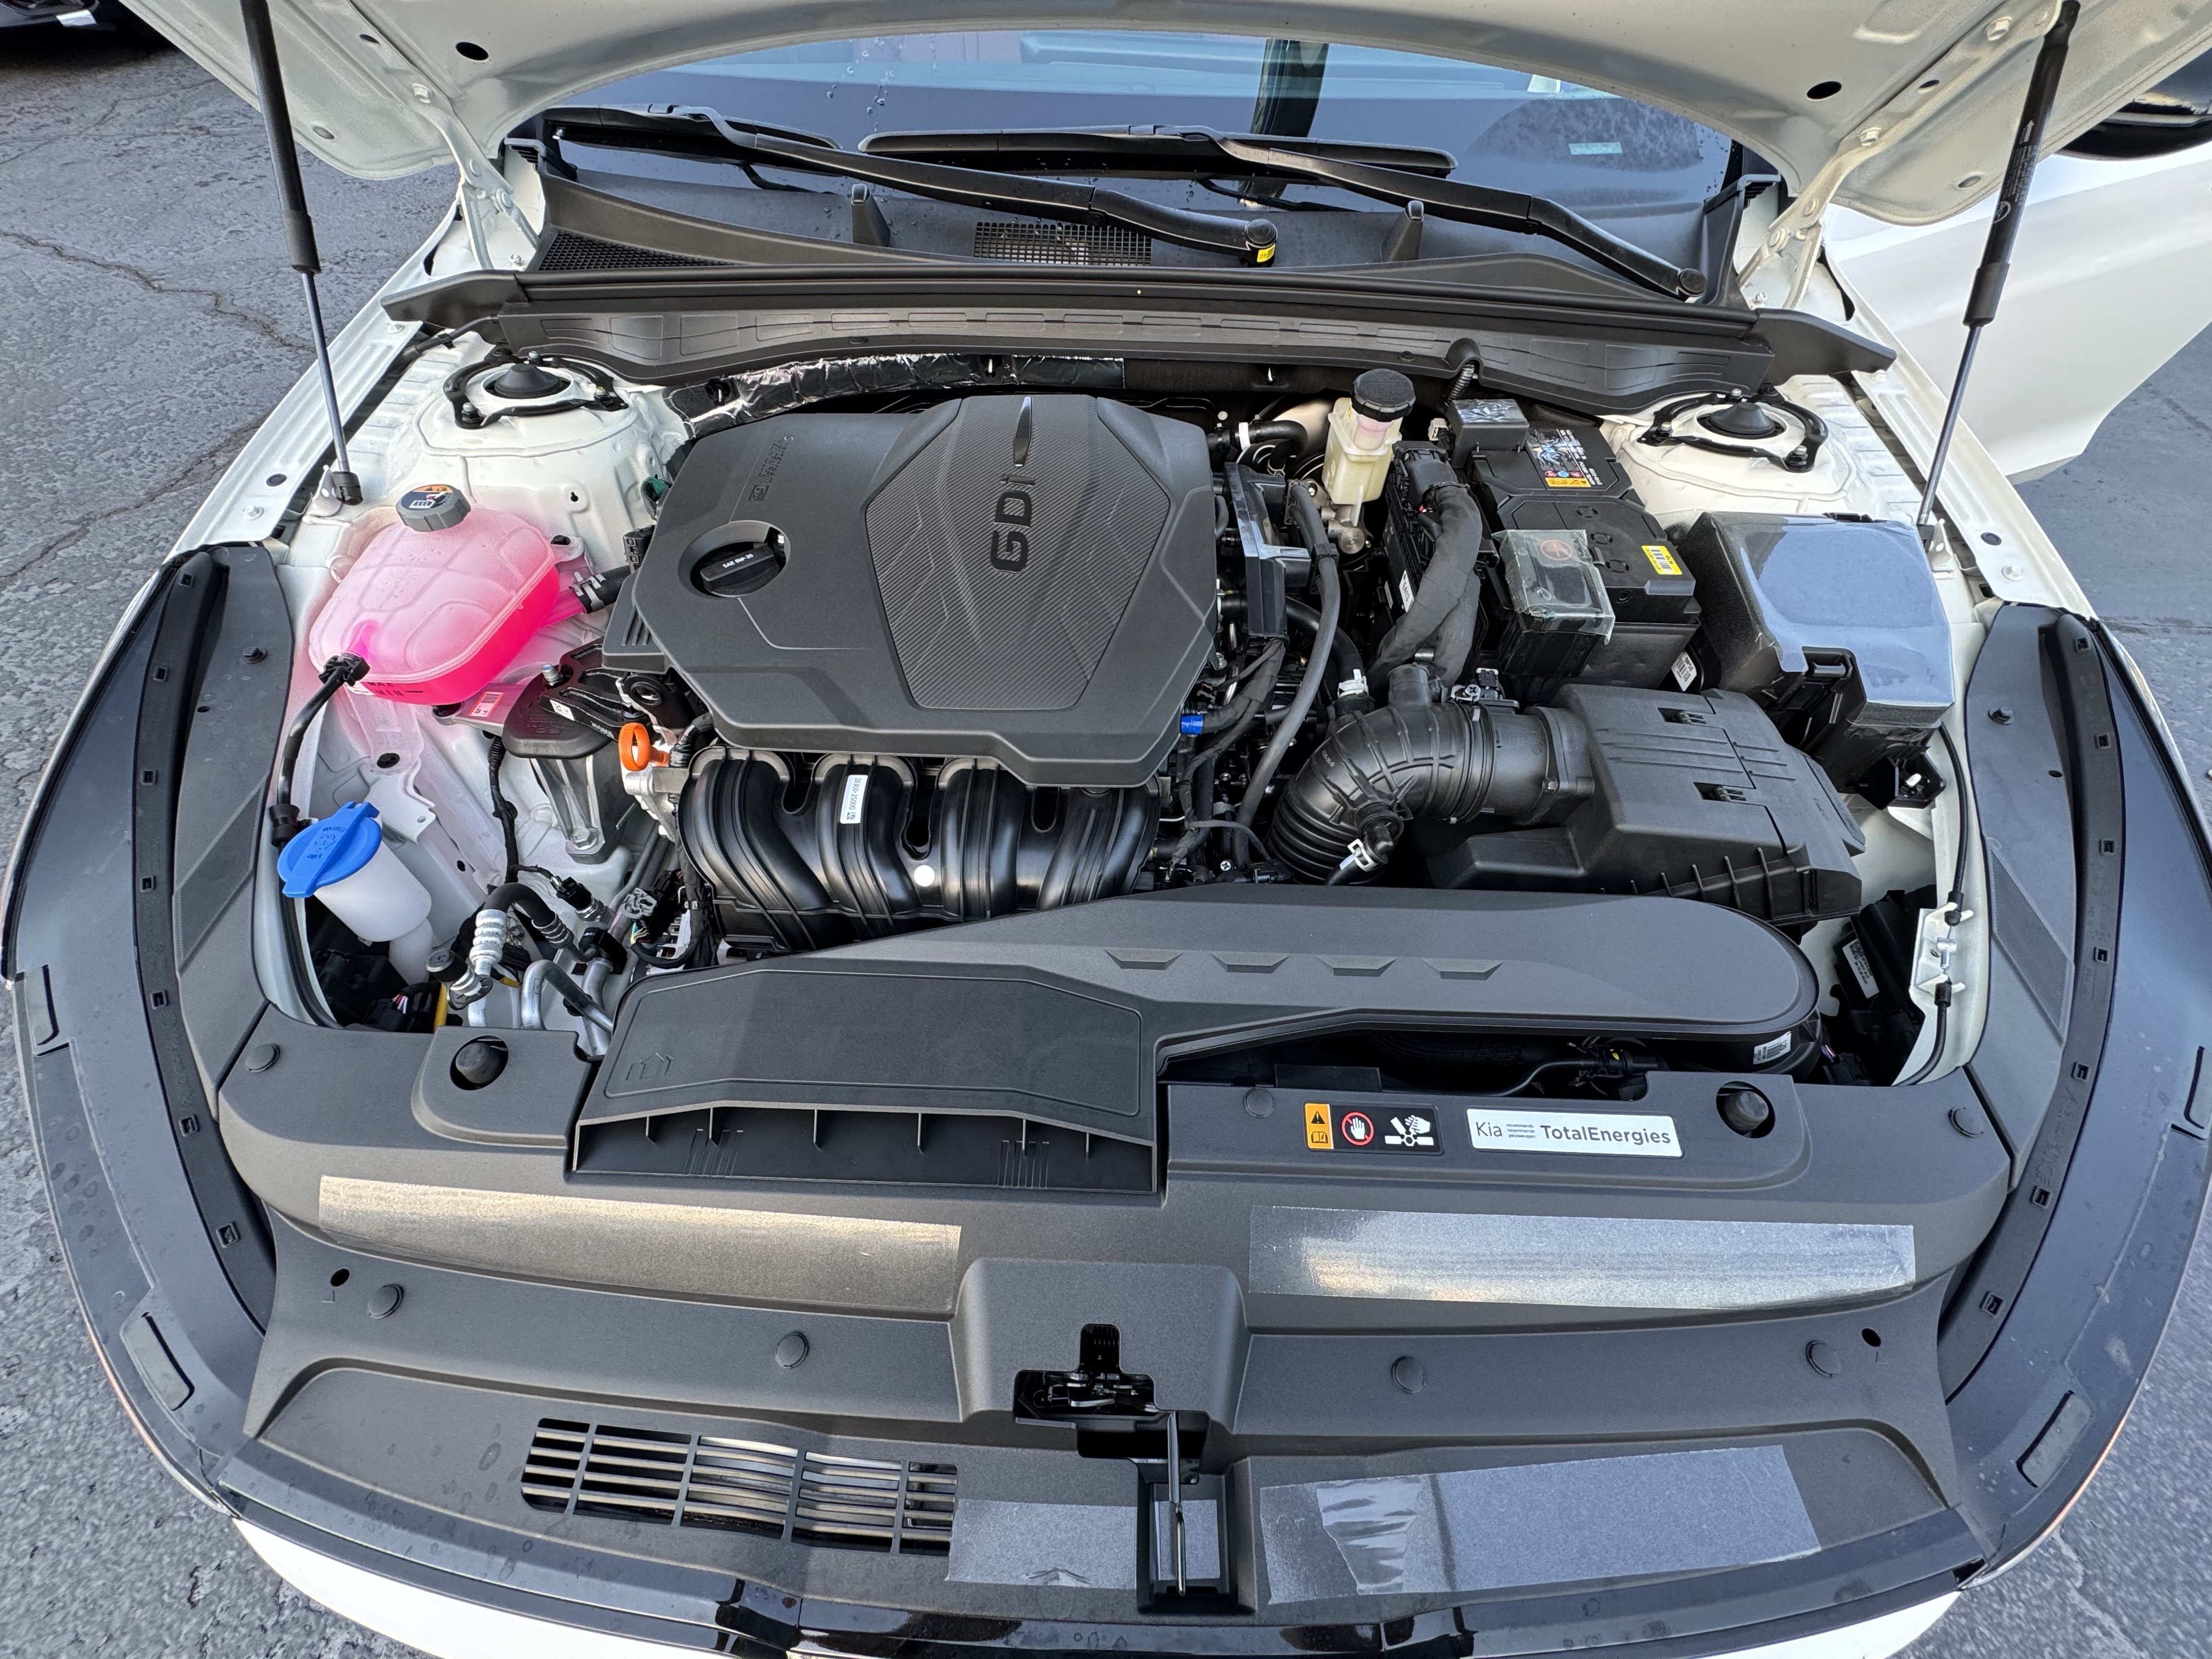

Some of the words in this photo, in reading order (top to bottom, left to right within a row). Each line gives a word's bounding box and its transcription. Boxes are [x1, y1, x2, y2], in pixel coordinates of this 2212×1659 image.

[758, 439, 780, 483] TECHNOLOGY
[763, 436, 794, 483] Smartstream
[990, 474, 1036, 574] GDi
[735, 554, 754, 563] 0W-20
[1476, 1121, 1503, 1137] Kia
[1539, 1125, 1671, 1146] TotalEnergies
